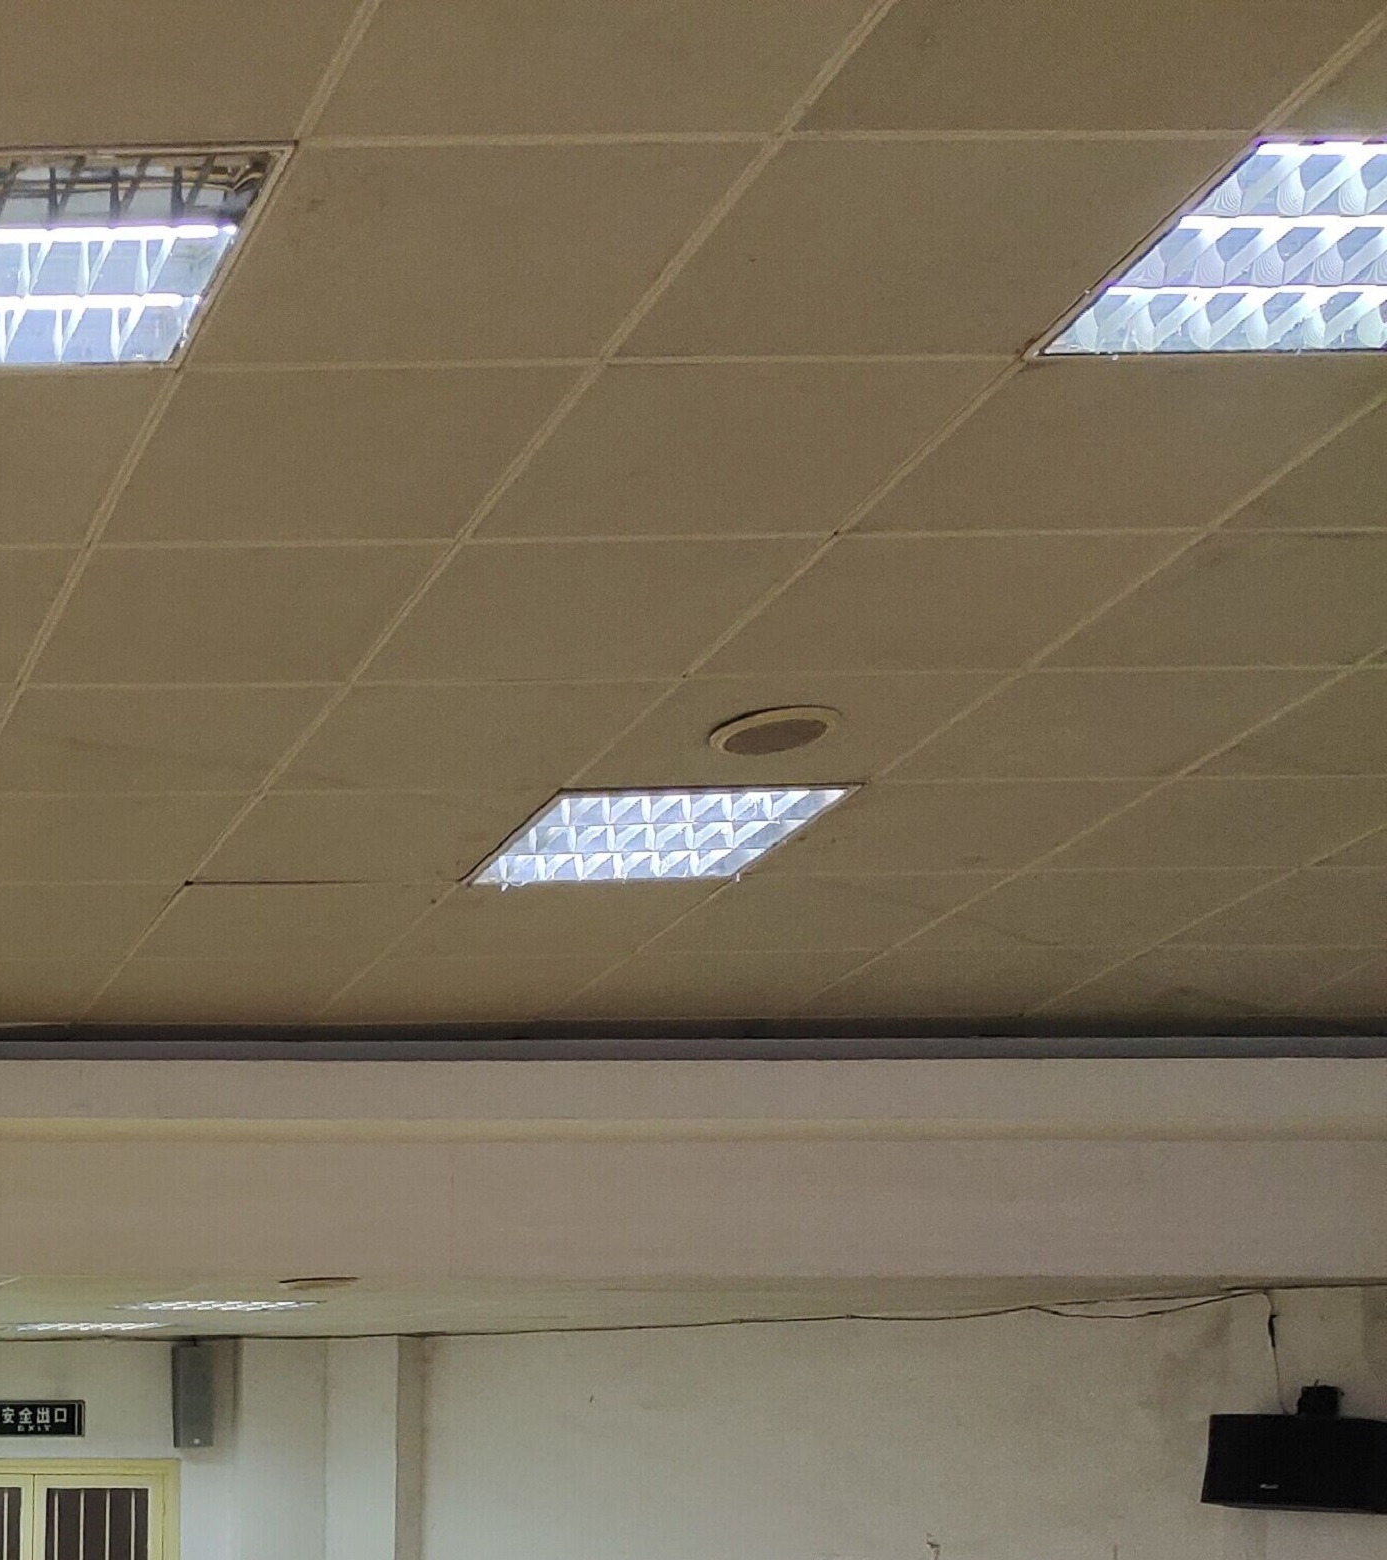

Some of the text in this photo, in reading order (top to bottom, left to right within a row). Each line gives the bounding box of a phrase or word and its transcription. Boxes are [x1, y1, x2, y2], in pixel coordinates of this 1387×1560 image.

[1, 1407, 67, 1424] 安全出口
[17, 1424, 52, 1432] EXIT
